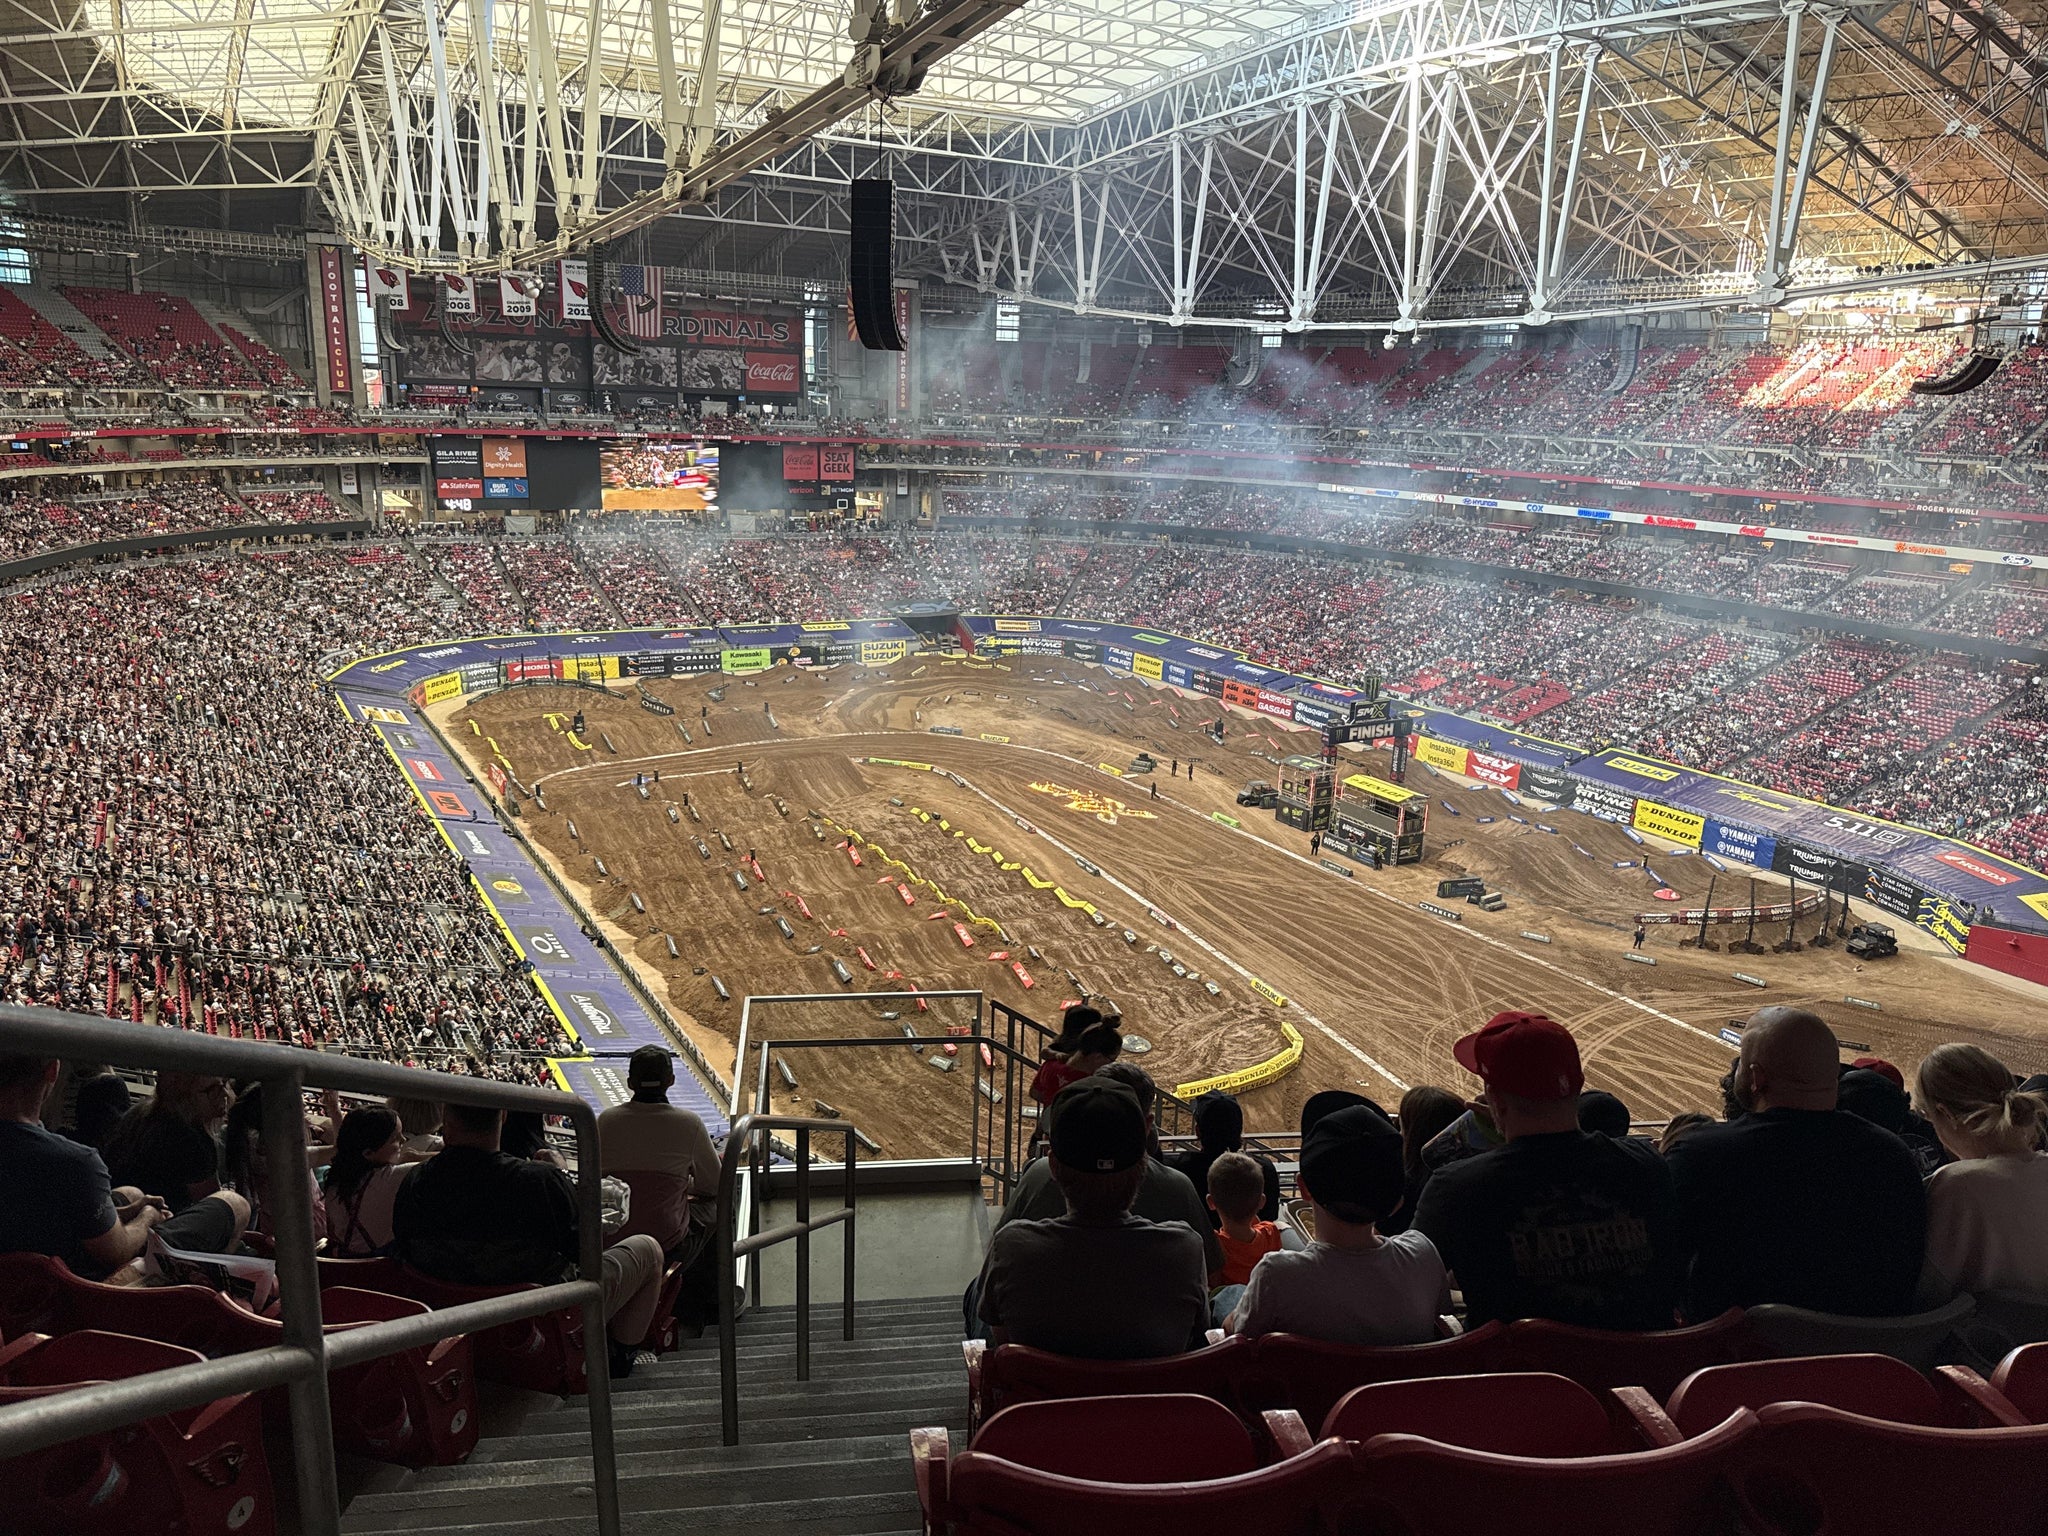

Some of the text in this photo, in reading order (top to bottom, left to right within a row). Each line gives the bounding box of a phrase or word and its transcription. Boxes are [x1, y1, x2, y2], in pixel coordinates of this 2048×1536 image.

[390, 298, 404, 307] 08
[446, 301, 471, 310] 008
[506, 305, 532, 314] 2009
[327, 261, 345, 388] FOOTBALL CLUB
[618, 312, 789, 342] CRDINALS
[748, 362, 797, 382] Coca-Cola
[825, 452, 849, 462] SEAT
[823, 463, 851, 474] GEEK
[1615, 479, 1641, 487] TILLMAN
[1472, 499, 1498, 507] HYUNDAI
[1526, 504, 1544, 513] COX
[1916, 504, 1944, 513] ROGER
[1945, 507, 1979, 516] WEHRLI
[729, 650, 762, 658] Kawasaki
[863, 642, 905, 651] SUZUKI
[1108, 646, 1133, 657] FALKEN
[863, 651, 904, 660] SUZUKI
[1108, 656, 1132, 667] FALKEN
[1139, 657, 1161, 667] DUNLOP
[730, 661, 763, 669] Kawasaki
[1138, 666, 1161, 676] DUNLOP
[1258, 691, 1292, 706] GASGAS
[1258, 702, 1292, 717] GASGAS
[1301, 705, 1329, 719] Husqvarna
[1356, 703, 1387, 719] SMX
[1348, 723, 1395, 740] FINISH
[1429, 742, 1456, 756] Insta360
[1427, 754, 1454, 768] Insta360
[1475, 752, 1516, 770] FLY
[1611, 759, 1674, 778] SUZUKI
[1472, 764, 1513, 783] FLY
[1532, 772, 1558, 785] TRIUMPH
[1360, 780, 1406, 799] DUNLOP
[1530, 785, 1557, 798] TRIUMPH
[1605, 789, 1634, 803] MOUNTAIN
[1650, 807, 1700, 826] DUNLOP
[1648, 822, 1697, 841] DUNLOP
[1823, 816, 1878, 838] 5.11
[1729, 829, 1758, 844] YAMAHA
[1726, 843, 1755, 859] YAMAHA
[1792, 848, 1828, 865] TRIUMPH
[1790, 864, 1824, 880] TRIUMPH
[1956, 859, 2007, 883] HONDA
[1881, 881, 1913, 899] COMMISSION
[1882, 875, 1914, 893] UTAH SPORTS
[1877, 897, 1909, 915] COMMISSION
[1878, 892, 1910, 910] UTAH SPORTS
[1937, 907, 1971, 937] alpinestars
[1932, 923, 1967, 954] alpinestars
[1254, 981, 1280, 1003] SUZUKI
[578, 1001, 613, 1036] TRIUMPH
[1275, 1052, 1297, 1069] DUNLOP
[590, 1066, 611, 1089] SPORTS
[1239, 1067, 1269, 1082] DUNLOP
[602, 1067, 631, 1102] OMMISSION
[1189, 1080, 1229, 1095] DUNLOP
